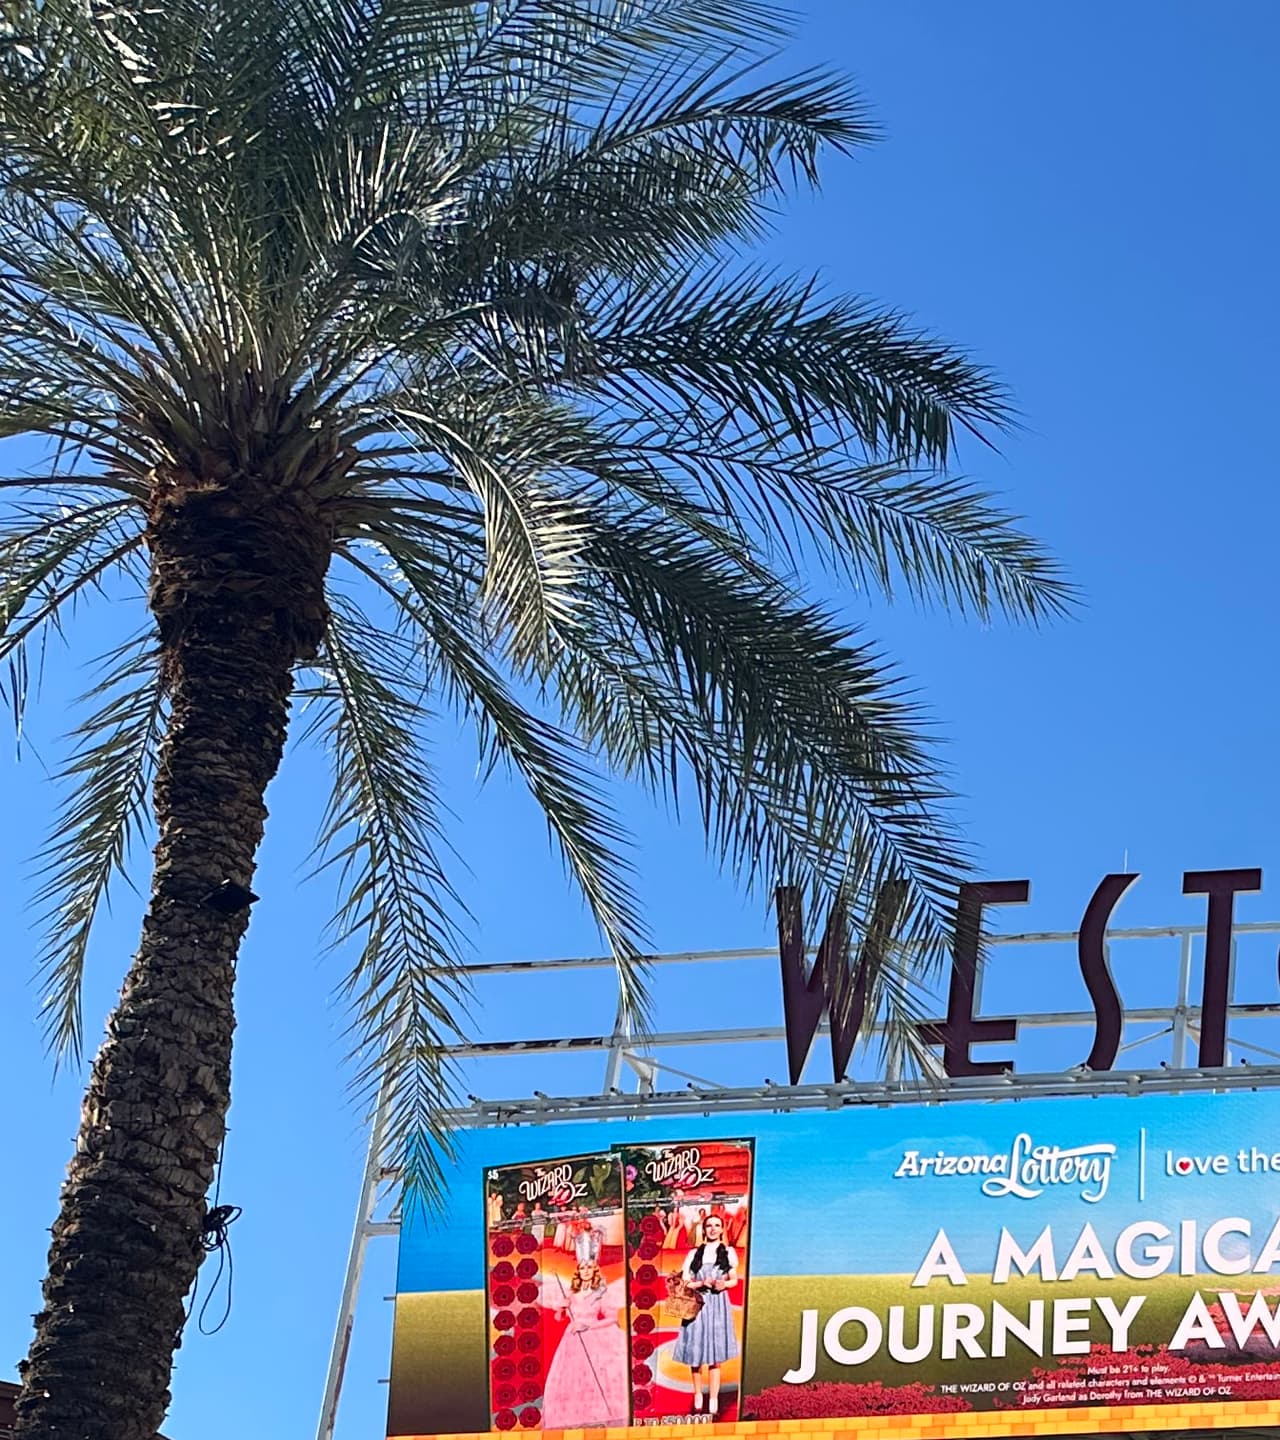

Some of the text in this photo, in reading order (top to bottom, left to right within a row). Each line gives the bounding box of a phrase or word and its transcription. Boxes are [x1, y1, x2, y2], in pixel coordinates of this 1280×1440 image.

[646, 1147, 700, 1182] WIZARD
[895, 1132, 1117, 1202] Arizona Lottery
[1166, 1150, 1229, 1176] love
[519, 1164, 572, 1201] WIZARD
[911, 1227, 968, 1287] A
[782, 1296, 1146, 1384] JOURNEY
[941, 1384, 957, 1393] THE
[960, 1383, 996, 1393] WIZARD
[998, 1382, 1010, 1392] OF
[1012, 1381, 1026, 1391] OZ
[1028, 1380, 1044, 1391] and
[1046, 1380, 1056, 1389] all
[1057, 1379, 1086, 1389] related
[1087, 1377, 1130, 1388] characters
[1132, 1376, 1147, 1386] and
[1149, 1375, 1186, 1385] elements
[1218, 1373, 1243, 1383] Turner
[1087, 1366, 1107, 1375] Must
[1109, 1365, 1121, 1374] be
[1141, 1365, 1149, 1374] to
[1043, 1392, 1076, 1402] Garland
[1078, 1393, 1088, 1401] as
[1090, 1390, 1122, 1401] Dorothy
[1124, 1388, 1143, 1399] from
[1146, 1388, 1163, 1398] THE
[1164, 1387, 1201, 1397] WIZARD
[1203, 1386, 1216, 1395] OF
